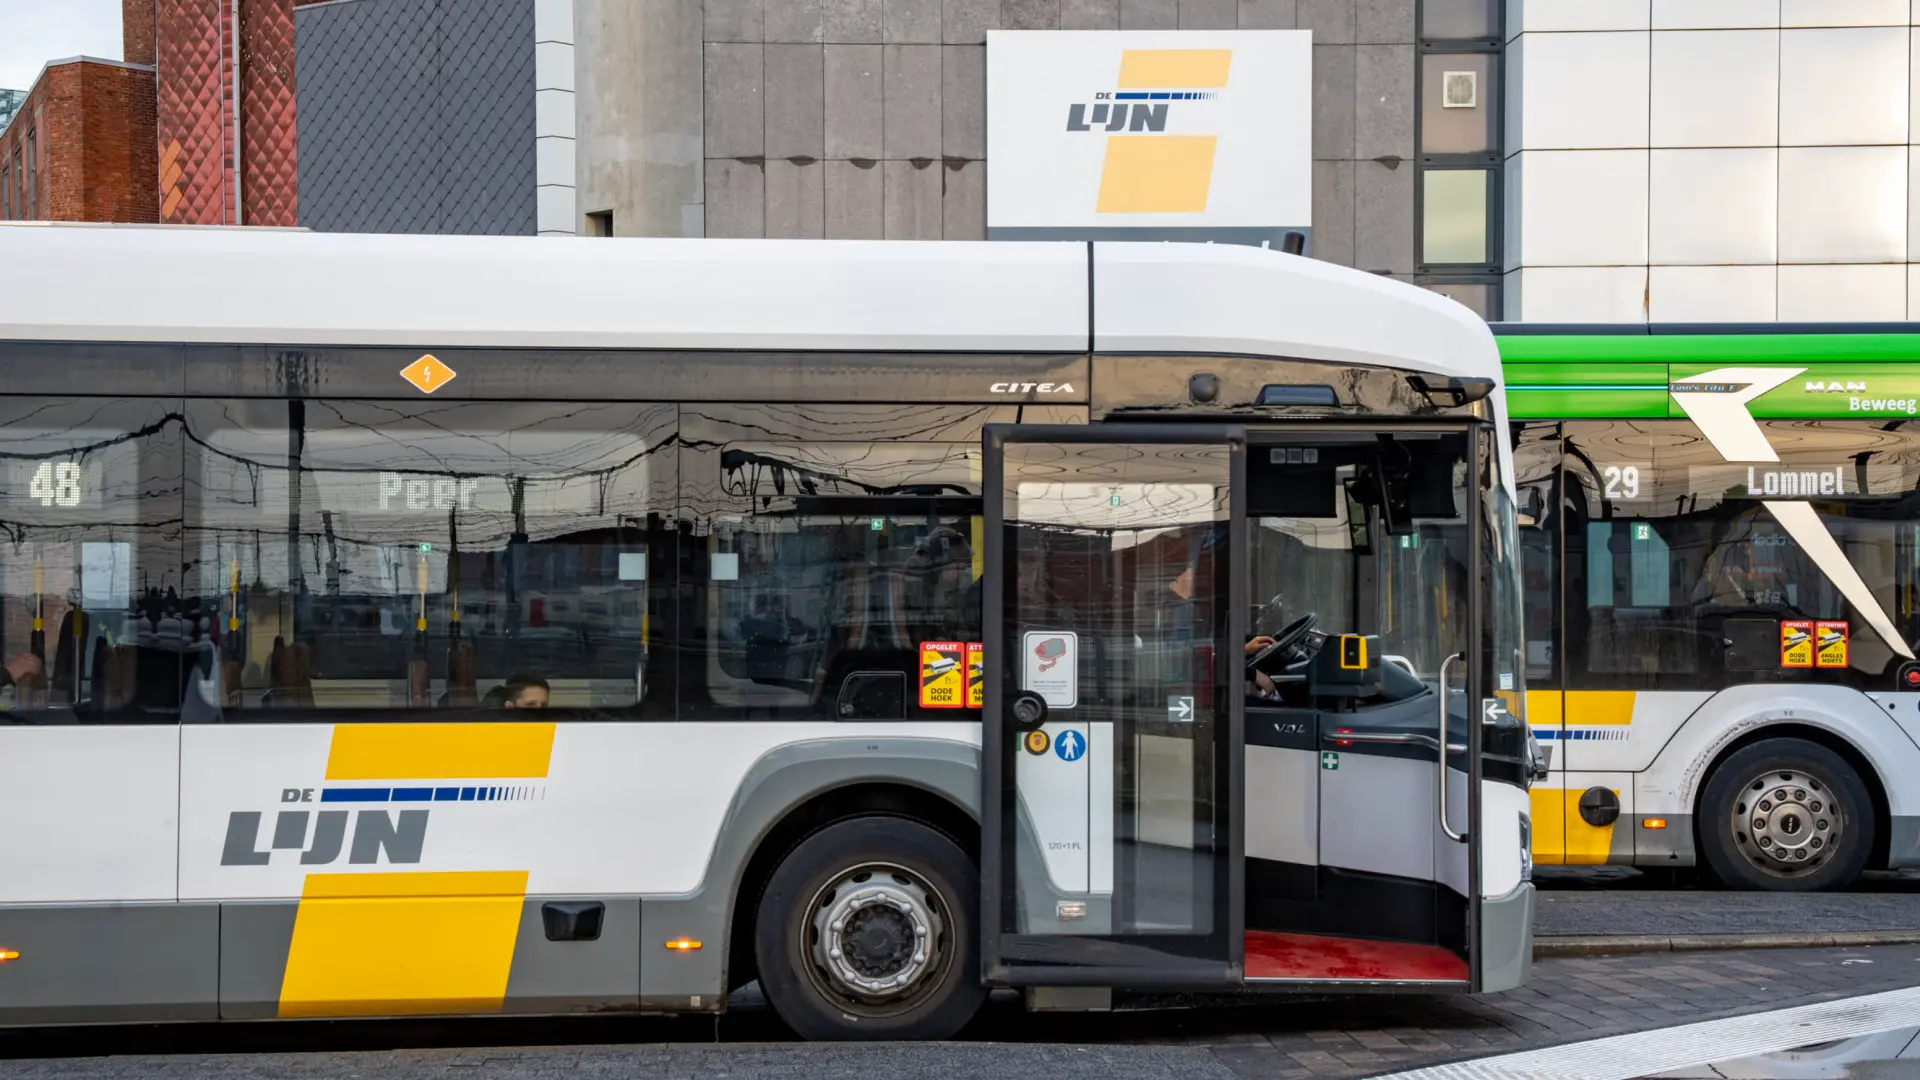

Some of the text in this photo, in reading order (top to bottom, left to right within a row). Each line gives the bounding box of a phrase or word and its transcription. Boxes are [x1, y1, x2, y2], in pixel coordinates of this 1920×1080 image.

[1095, 92, 1112, 100] DE
[1066, 103, 1169, 132] LIJN
[990, 382, 1075, 393] CITEA
[1805, 381, 1867, 393] MAN
[1849, 397, 1917, 414] Beweeg
[30, 462, 81, 506] 48
[380, 471, 477, 510] Peer
[1604, 466, 1639, 498] 29
[1747, 466, 1845, 495] Lommel
[281, 788, 315, 803] DE
[220, 810, 430, 866] LIJN
[1048, 842, 1071, 850] 120+1
